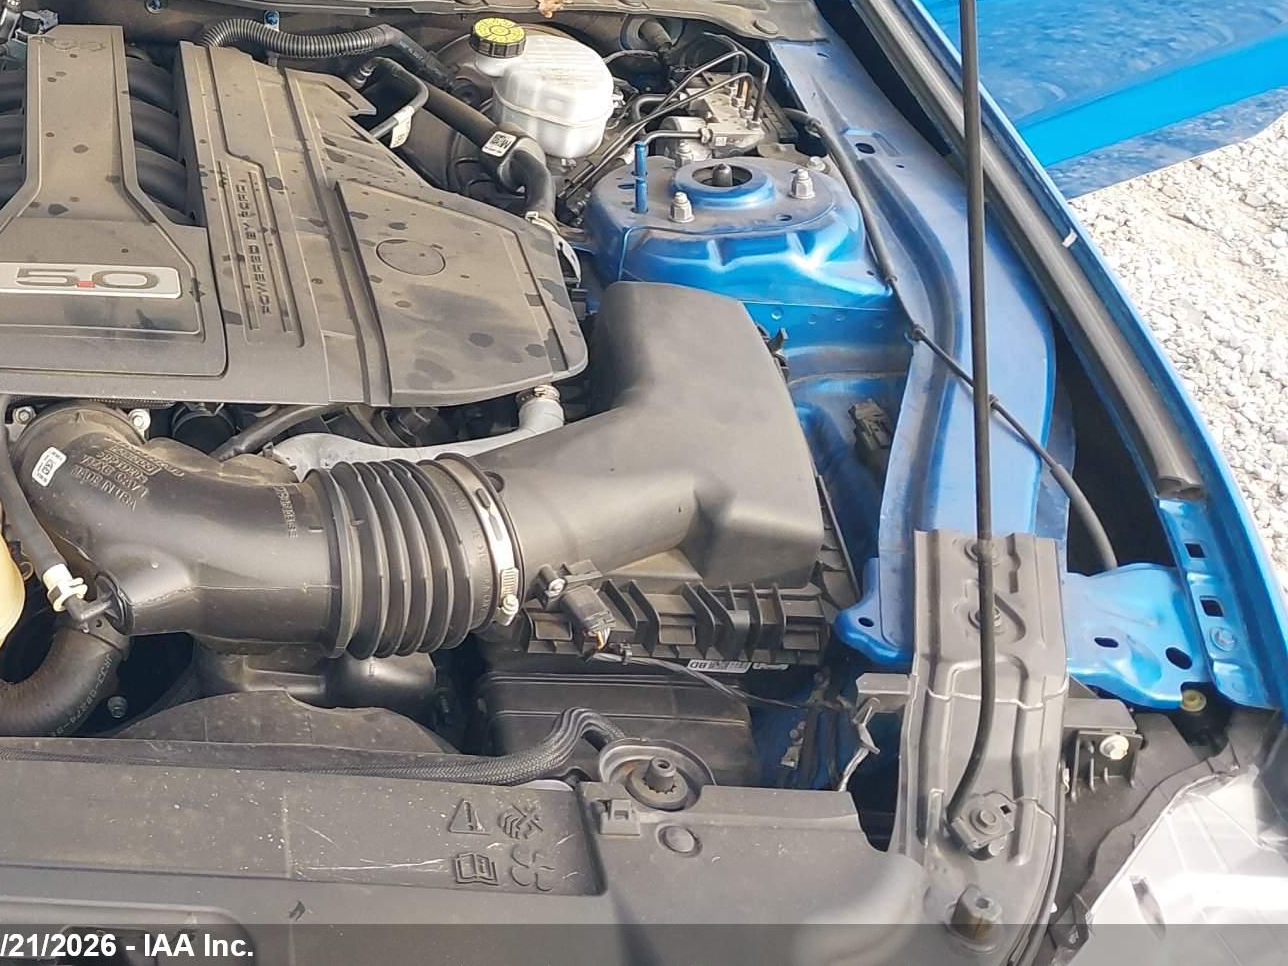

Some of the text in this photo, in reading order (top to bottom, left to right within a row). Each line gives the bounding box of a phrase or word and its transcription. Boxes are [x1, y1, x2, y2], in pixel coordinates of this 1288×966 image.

[16, 267, 159, 289] 5.0
[235, 185, 271, 315] POWERED BY FORD
